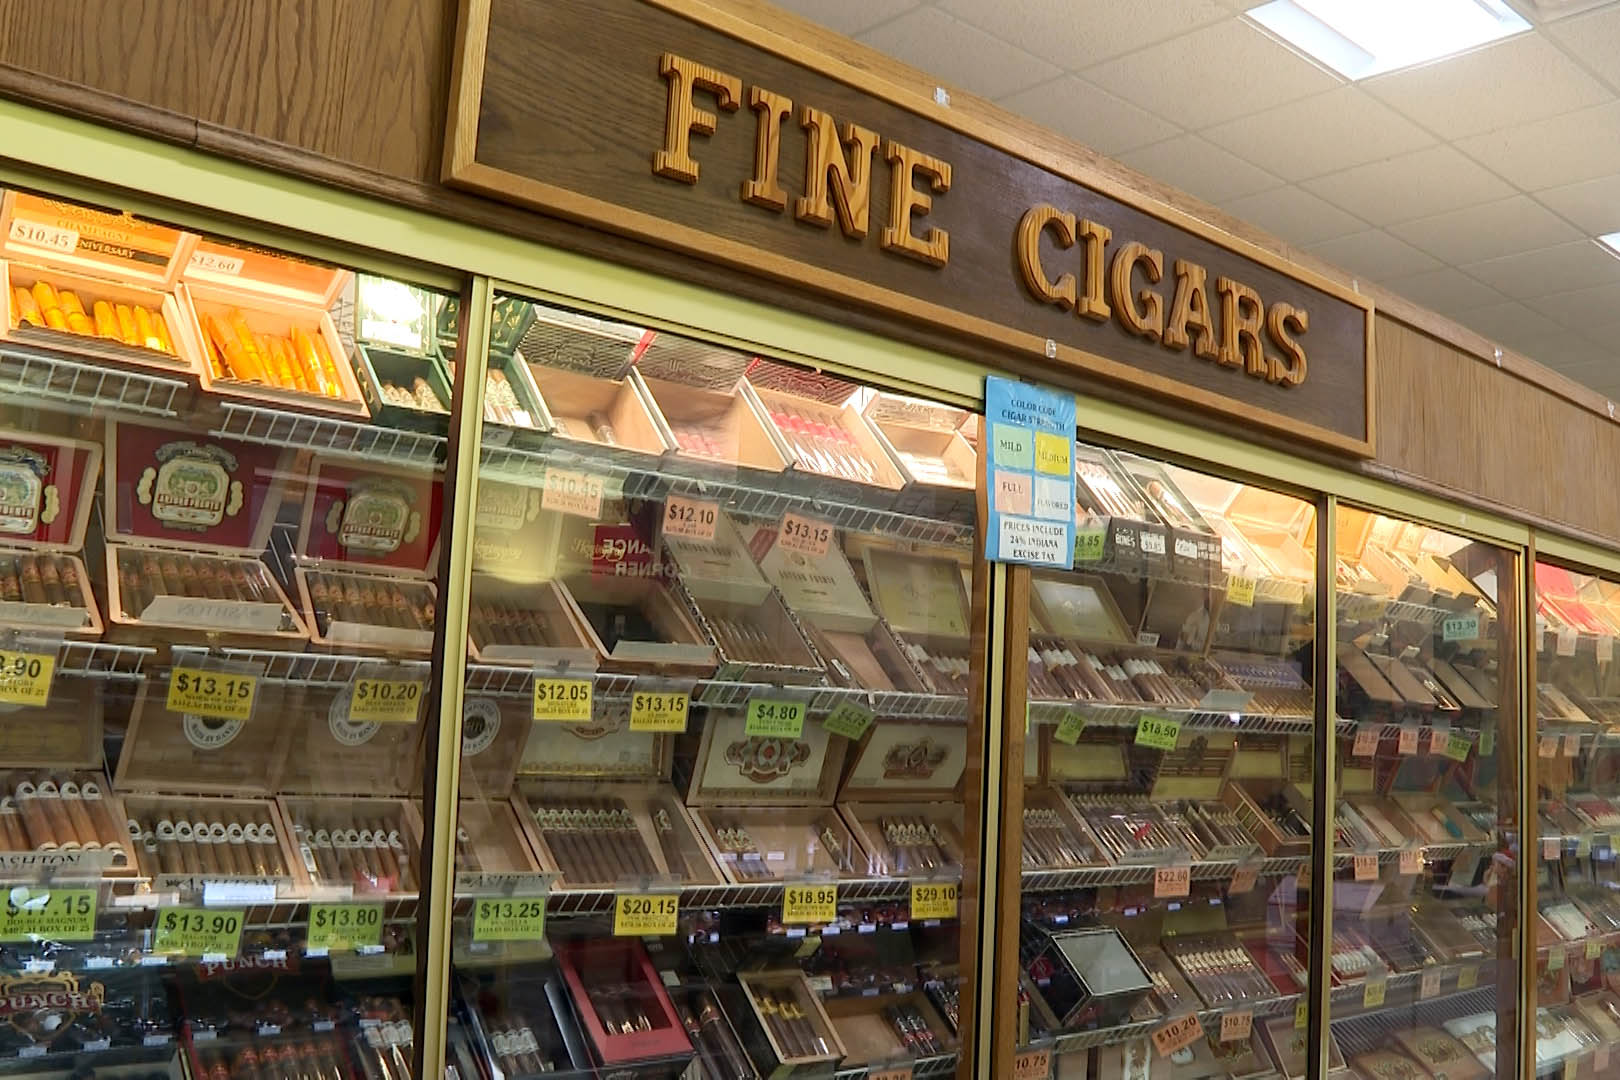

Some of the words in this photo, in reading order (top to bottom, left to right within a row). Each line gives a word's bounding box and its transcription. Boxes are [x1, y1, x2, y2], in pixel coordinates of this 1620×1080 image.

[652, 52, 952, 268] FINE
[1016, 203, 1310, 386] CIGARS
[15, 224, 69, 248] $10.45
[1011, 400, 1037, 411] COLOR
[1002, 409, 1027, 421] CIGAR
[1000, 440, 1022, 452] MILD
[1002, 481, 1023, 494] FULL
[668, 503, 714, 525] $12.10
[785, 519, 828, 542] $13.15
[1004, 521, 1031, 531] PRICES
[1033, 523, 1065, 536] INCLUDE
[1028, 537, 1059, 549] INDIANA
[1013, 549, 1040, 560] EXCISE
[1042, 551, 1056, 562] TAX
[176, 673, 251, 699] $13.15
[357, 682, 417, 700] $10.20
[537, 683, 588, 700] $12.05
[635, 695, 684, 712] $13.15
[757, 703, 798, 720] $4.80
[788, 889, 835, 905] $18.95
[915, 886, 955, 902] $29.10
[480, 902, 541, 920] $13.25
[622, 899, 676, 916] $20.15
[164, 911, 237, 935] $13.90
[315, 908, 378, 927] $13.80
[1156, 1015, 1197, 1044] $10.20
